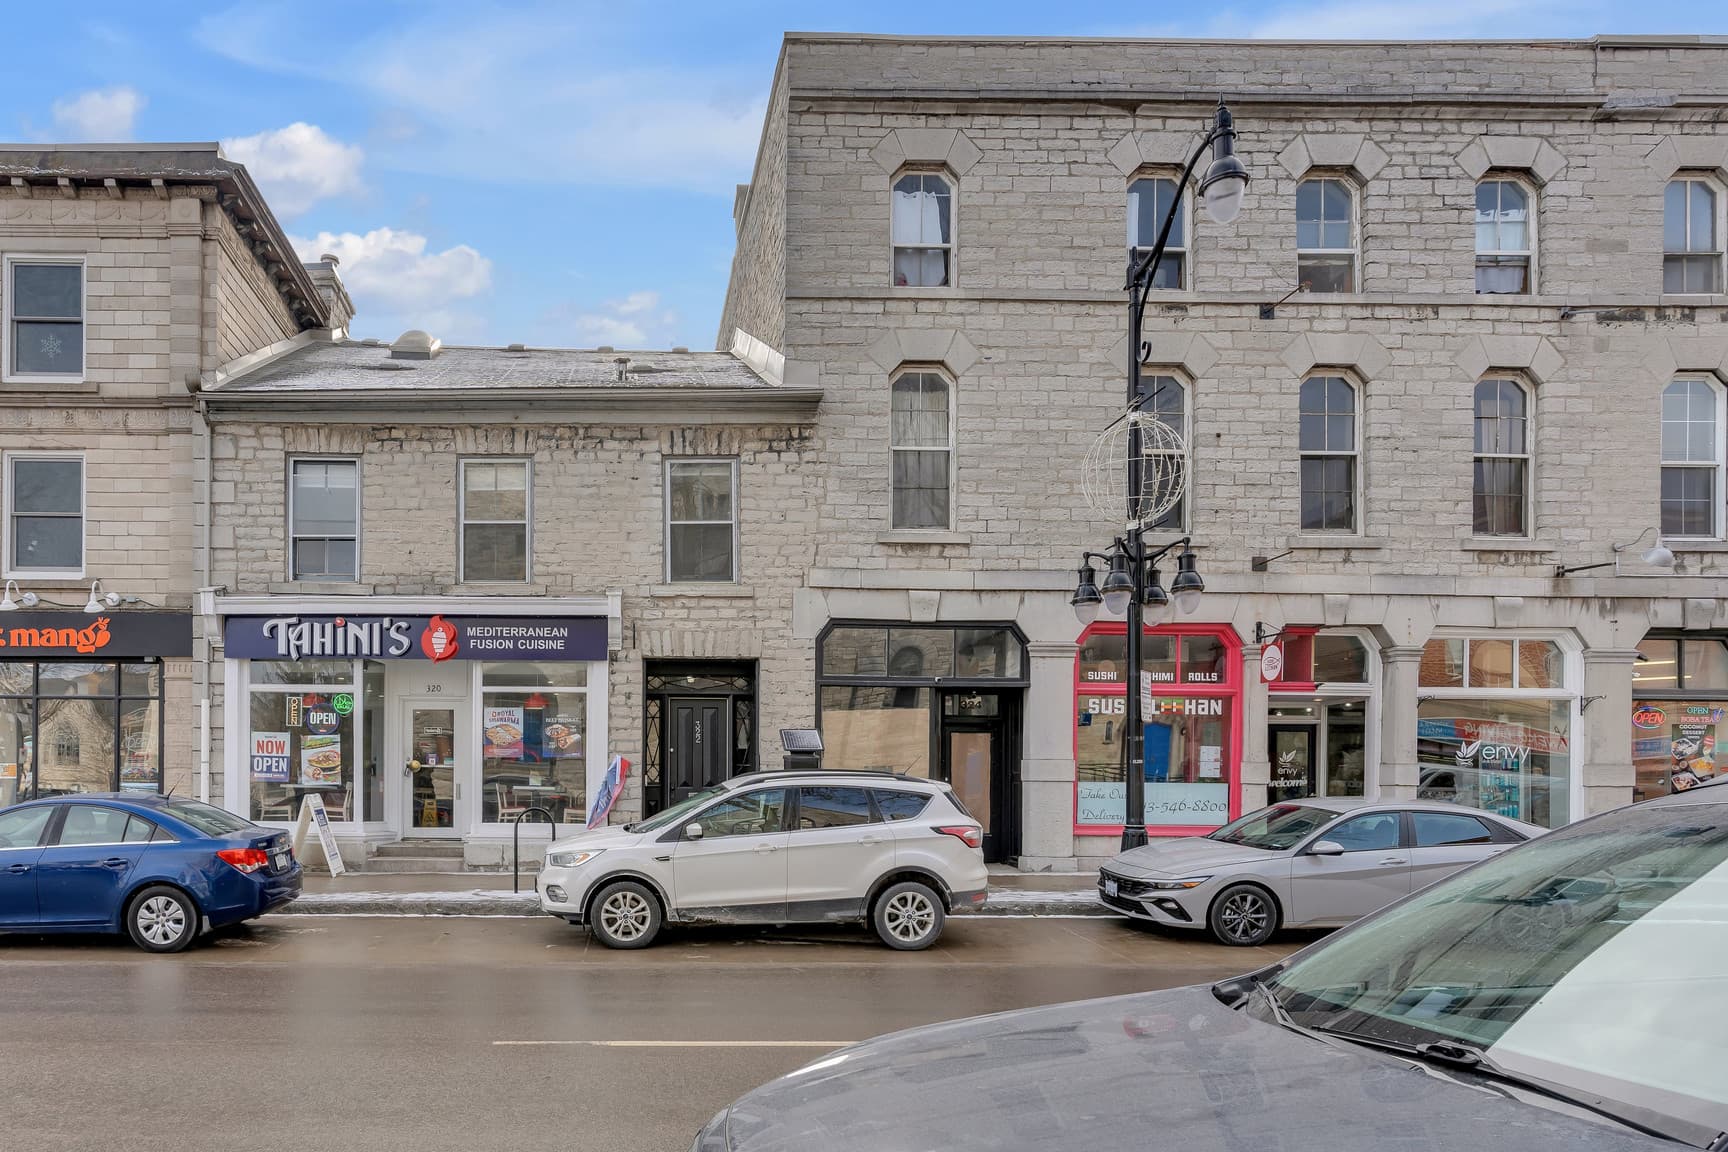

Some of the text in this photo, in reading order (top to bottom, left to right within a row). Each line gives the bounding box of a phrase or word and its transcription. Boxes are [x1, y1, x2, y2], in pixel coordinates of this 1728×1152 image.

[467, 626, 568, 637] MEDITERRANEAN
[263, 616, 411, 661] TAHINI'S
[470, 639, 565, 650] FUSION CUISINE
[1088, 671, 1117, 680] SUSHI
[1152, 672, 1174, 681] HIMI
[1188, 672, 1218, 682] ROLLS
[426, 684, 442, 693] 320
[310, 712, 337, 725] OPEN
[1634, 712, 1665, 724] OPEN
[256, 739, 286, 755] NOW
[1482, 745, 1530, 764] envy
[253, 757, 288, 772] OPEN
[1277, 767, 1298, 777] envy
[1082, 808, 1125, 824] Delivery
